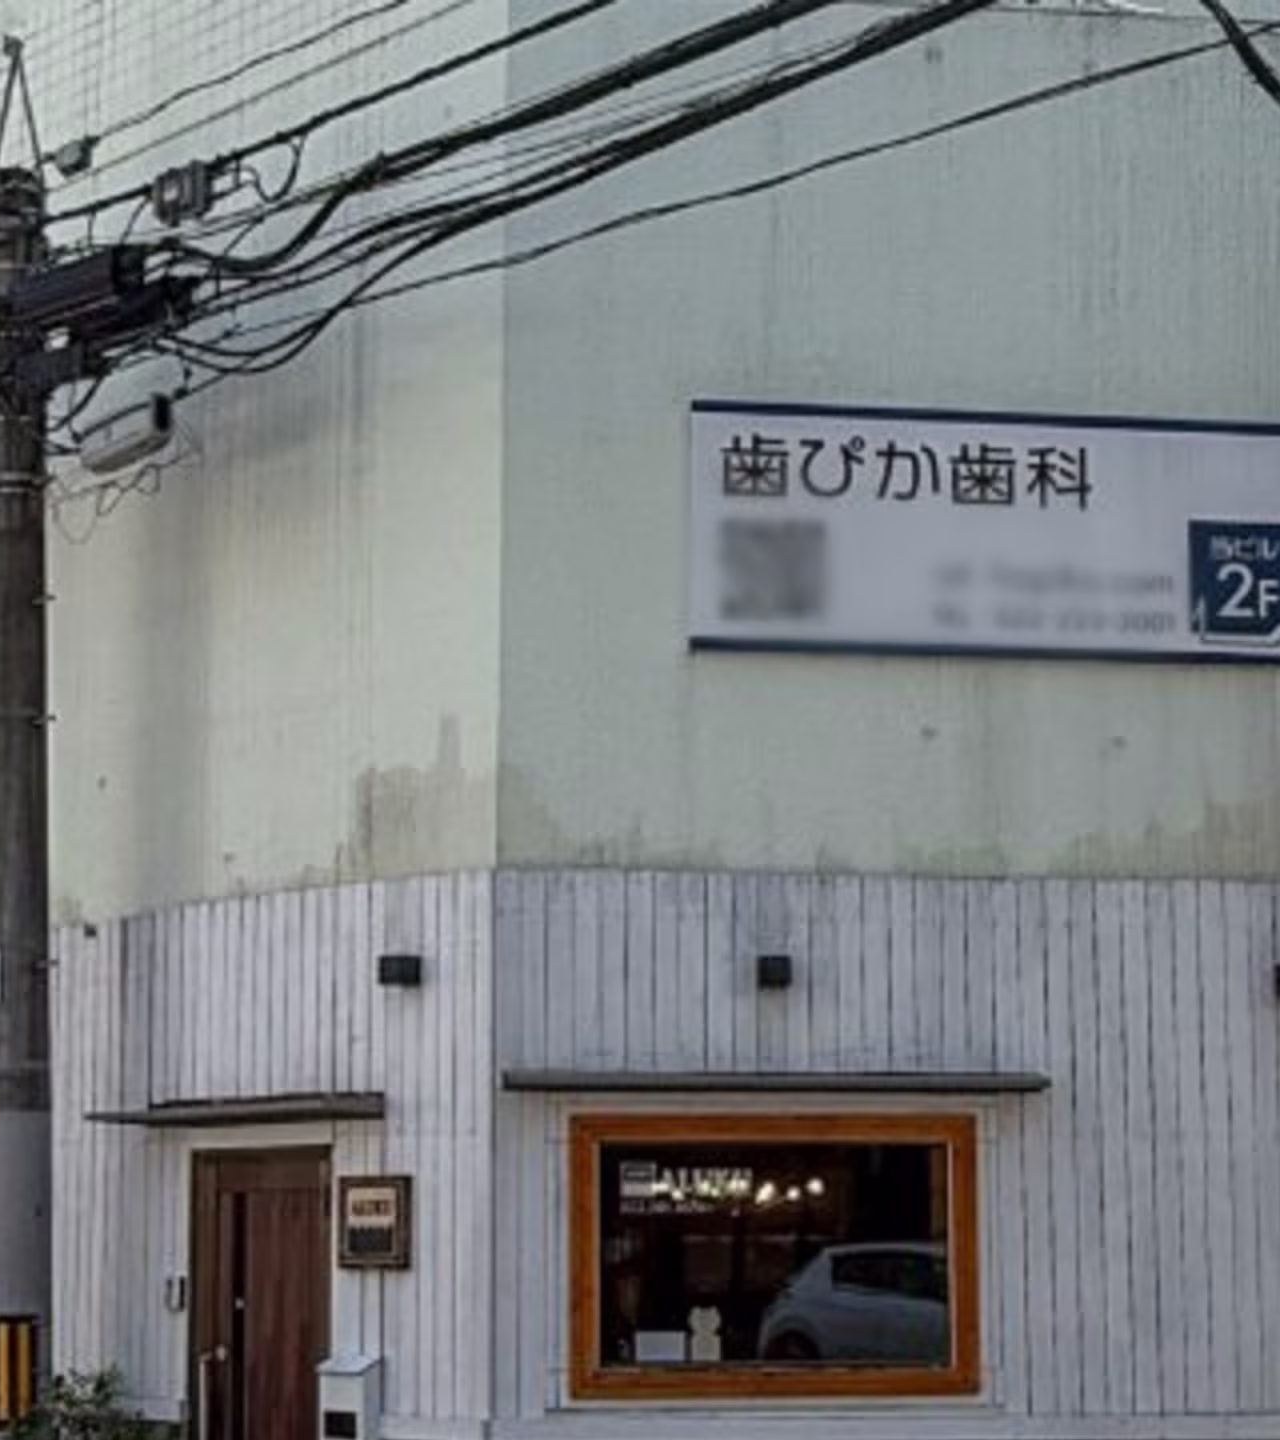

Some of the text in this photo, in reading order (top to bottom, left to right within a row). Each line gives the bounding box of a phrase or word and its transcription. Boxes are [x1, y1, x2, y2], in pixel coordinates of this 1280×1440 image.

[721, 434, 1093, 511] 歯ぴか歯科
[1217, 562, 1280, 618] 2F
